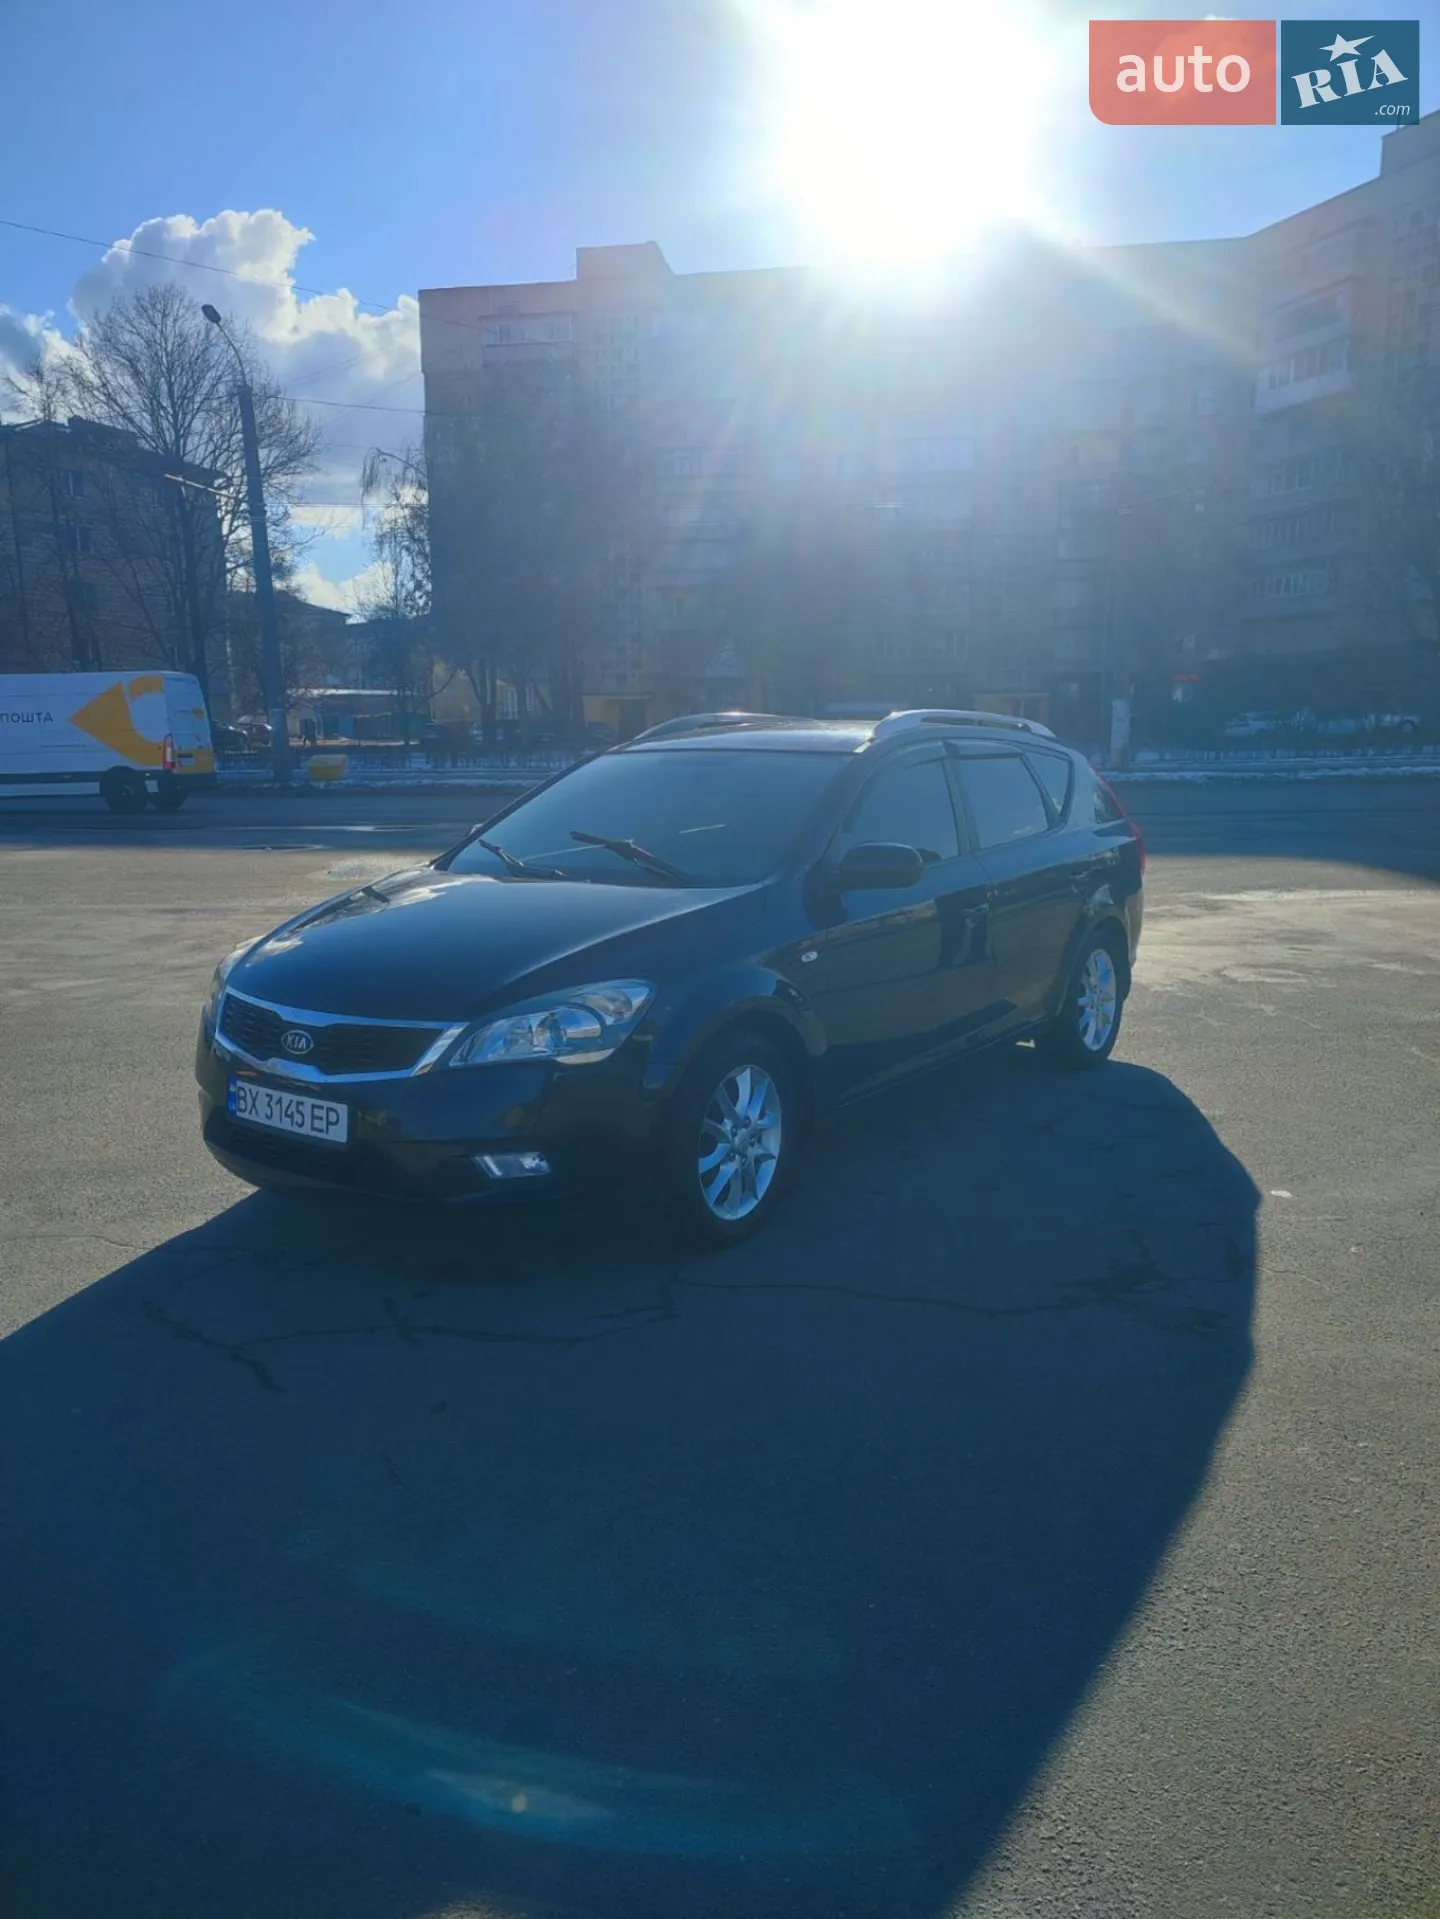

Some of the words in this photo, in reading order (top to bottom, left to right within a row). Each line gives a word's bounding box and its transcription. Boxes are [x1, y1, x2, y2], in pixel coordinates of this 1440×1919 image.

[0, 712, 53, 723] ПОШТА
[285, 1034, 307, 1049] KIA
[237, 1086, 260, 1117] BX
[264, 1093, 305, 1128] 3145
[310, 1103, 340, 1134] EP
